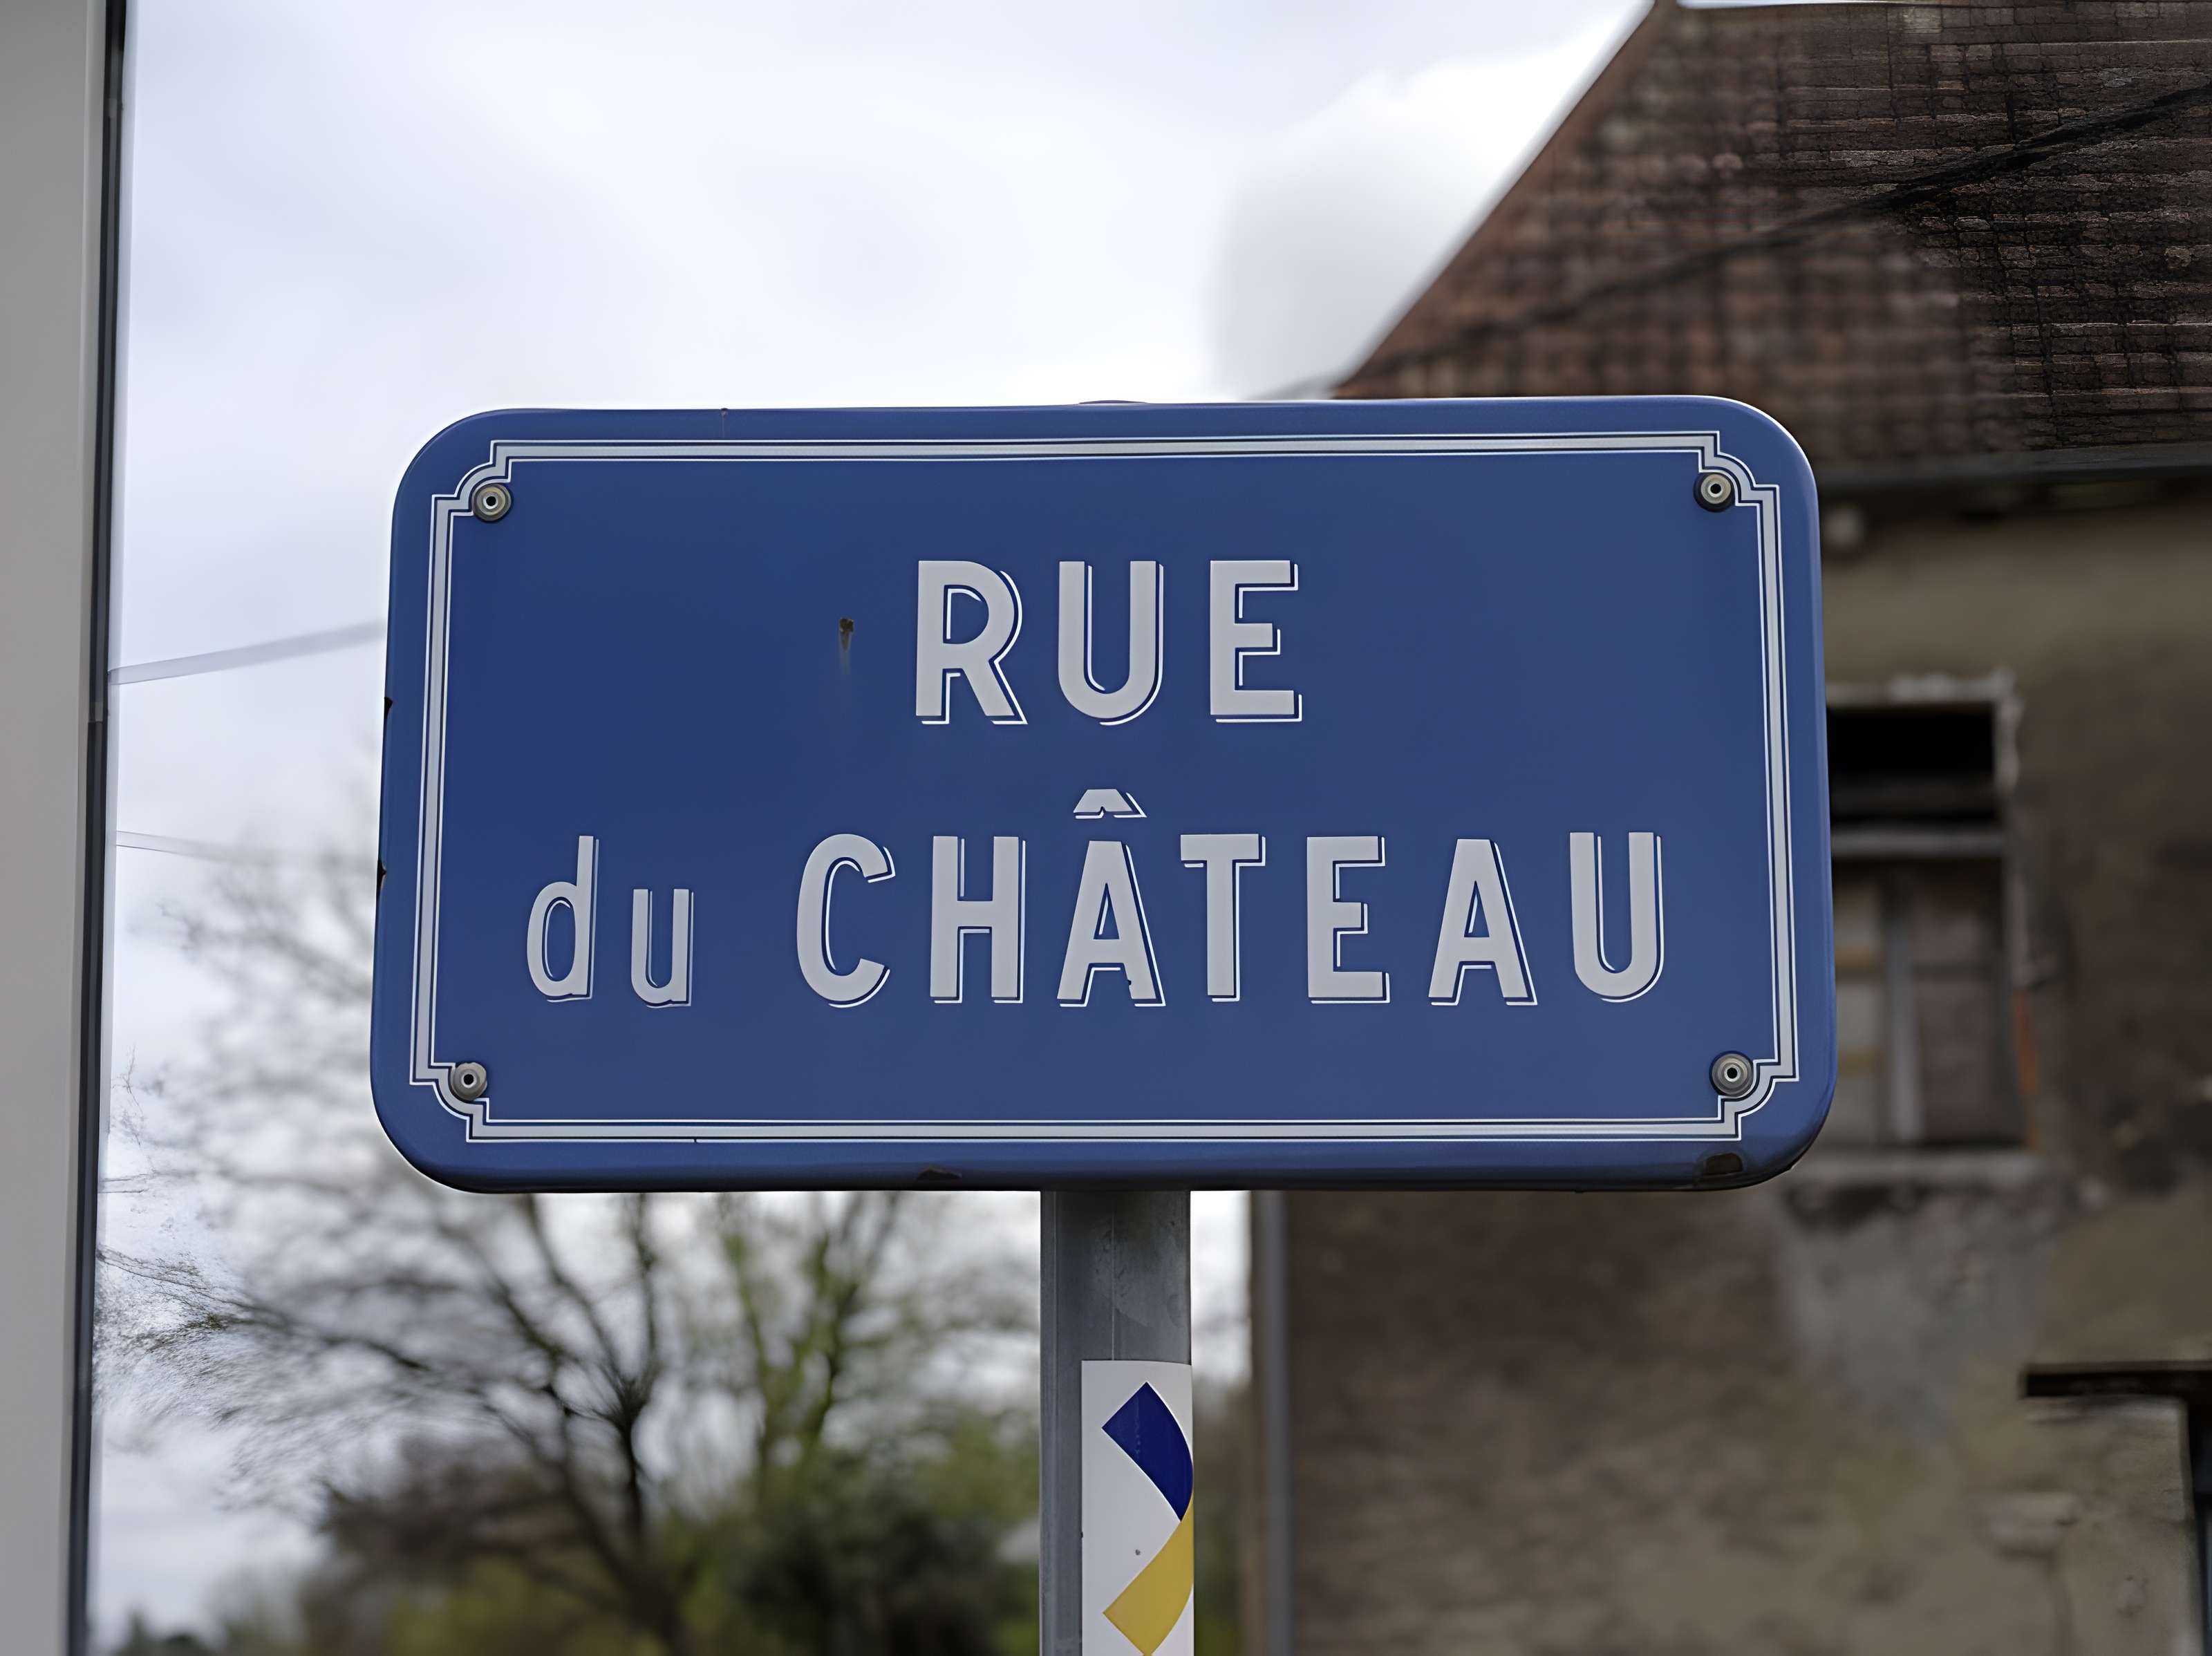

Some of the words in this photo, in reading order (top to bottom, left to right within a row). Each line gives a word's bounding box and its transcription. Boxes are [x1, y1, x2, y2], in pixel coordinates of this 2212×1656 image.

[915, 560, 1304, 727] RUE
[526, 835, 695, 1008] du
[796, 789, 1665, 1008] CHÂTEAU
